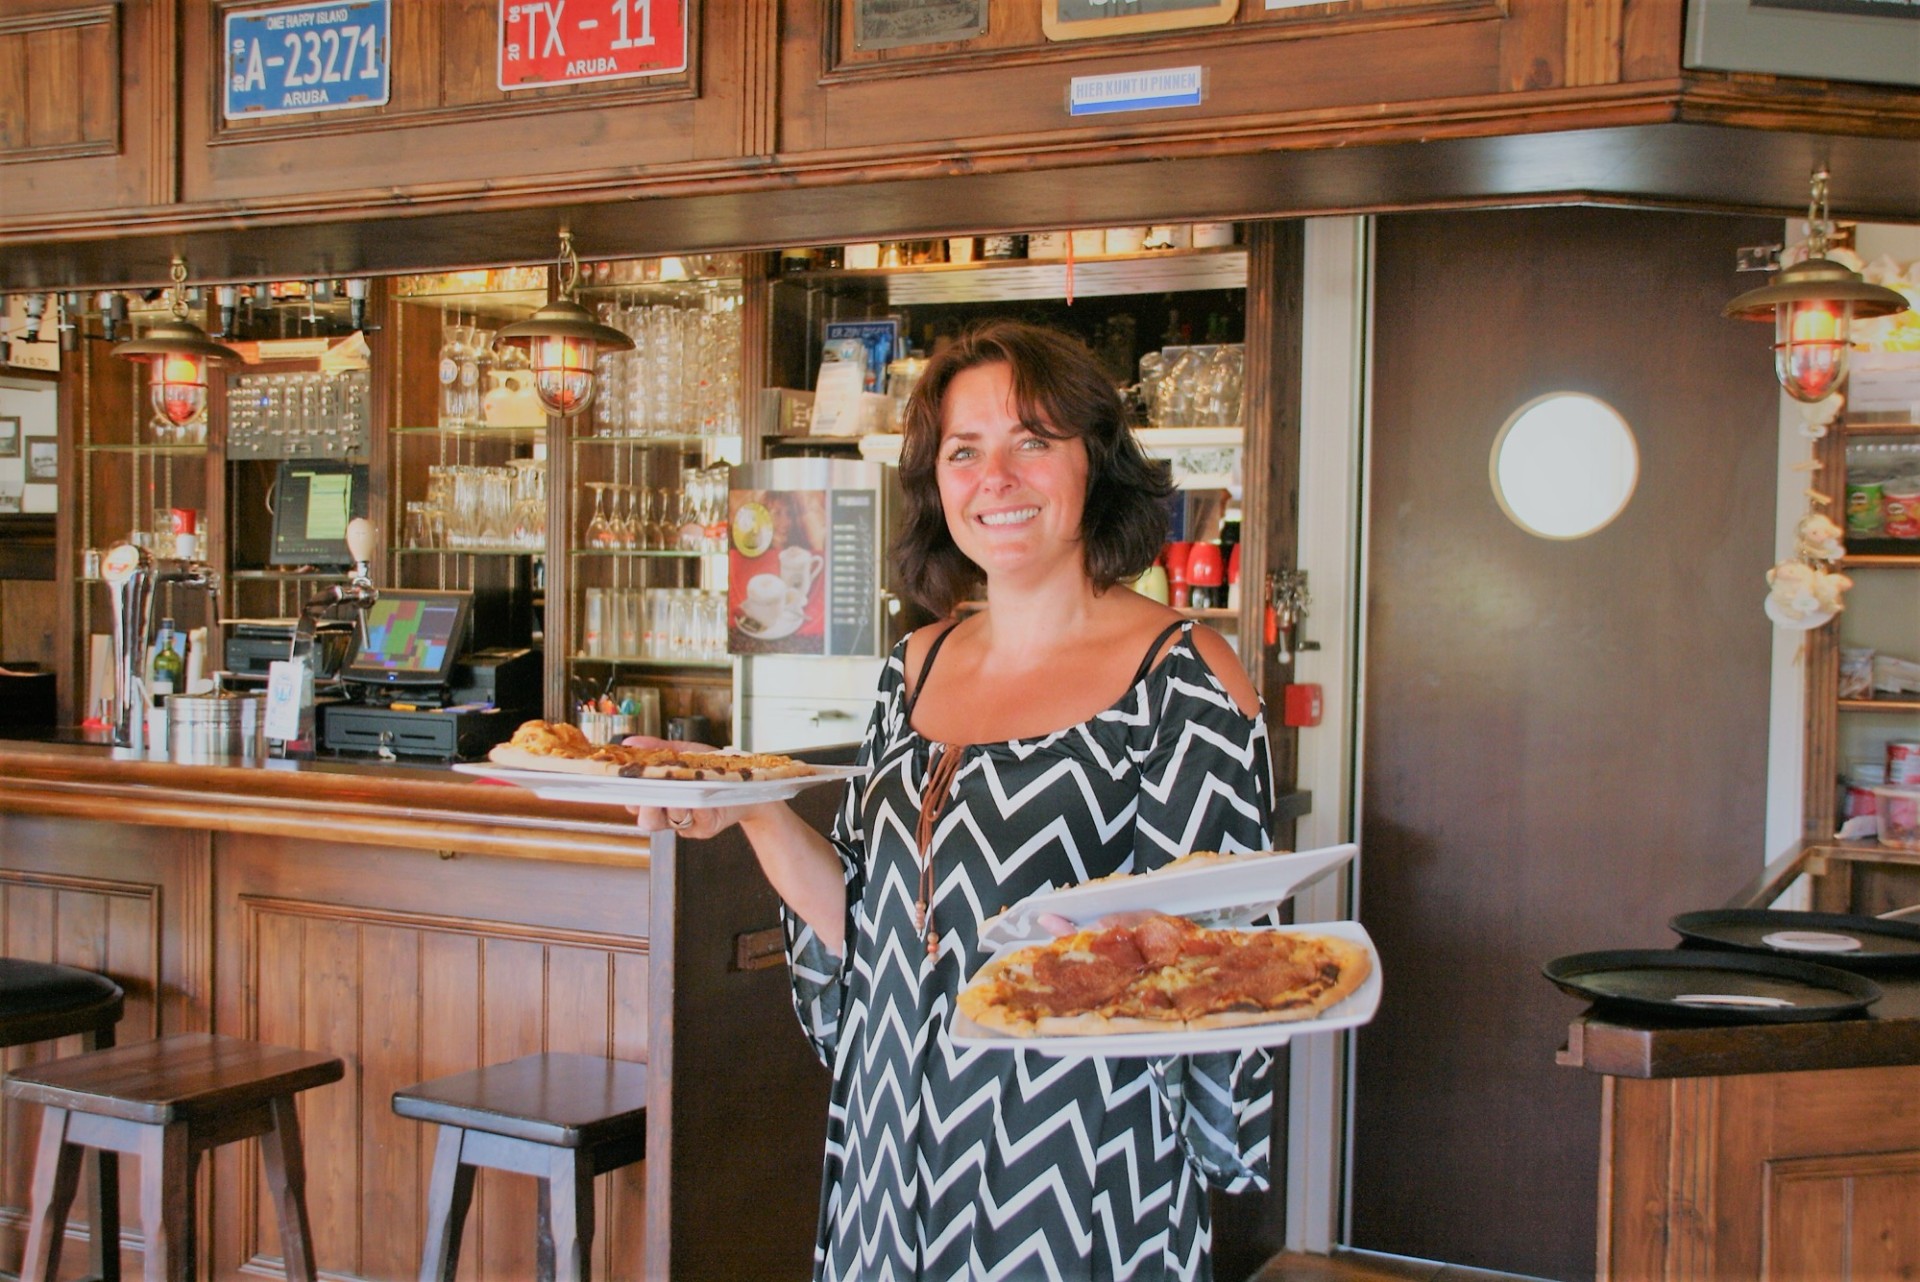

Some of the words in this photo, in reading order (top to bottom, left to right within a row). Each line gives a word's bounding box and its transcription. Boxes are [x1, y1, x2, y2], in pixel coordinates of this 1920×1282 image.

[267, 16, 285, 30] ONE
[286, 13, 315, 28] HAPPY
[317, 9, 348, 25] ISLAND
[245, 24, 379, 91] A-23271
[566, 58, 617, 76] ARUBA
[1076, 82, 1104, 99] HIER
[1106, 79, 1137, 96] KUNT
[1140, 78, 1148, 92] U
[1151, 73, 1196, 91] PINNEN
[284, 90, 329, 107] ARUBA
